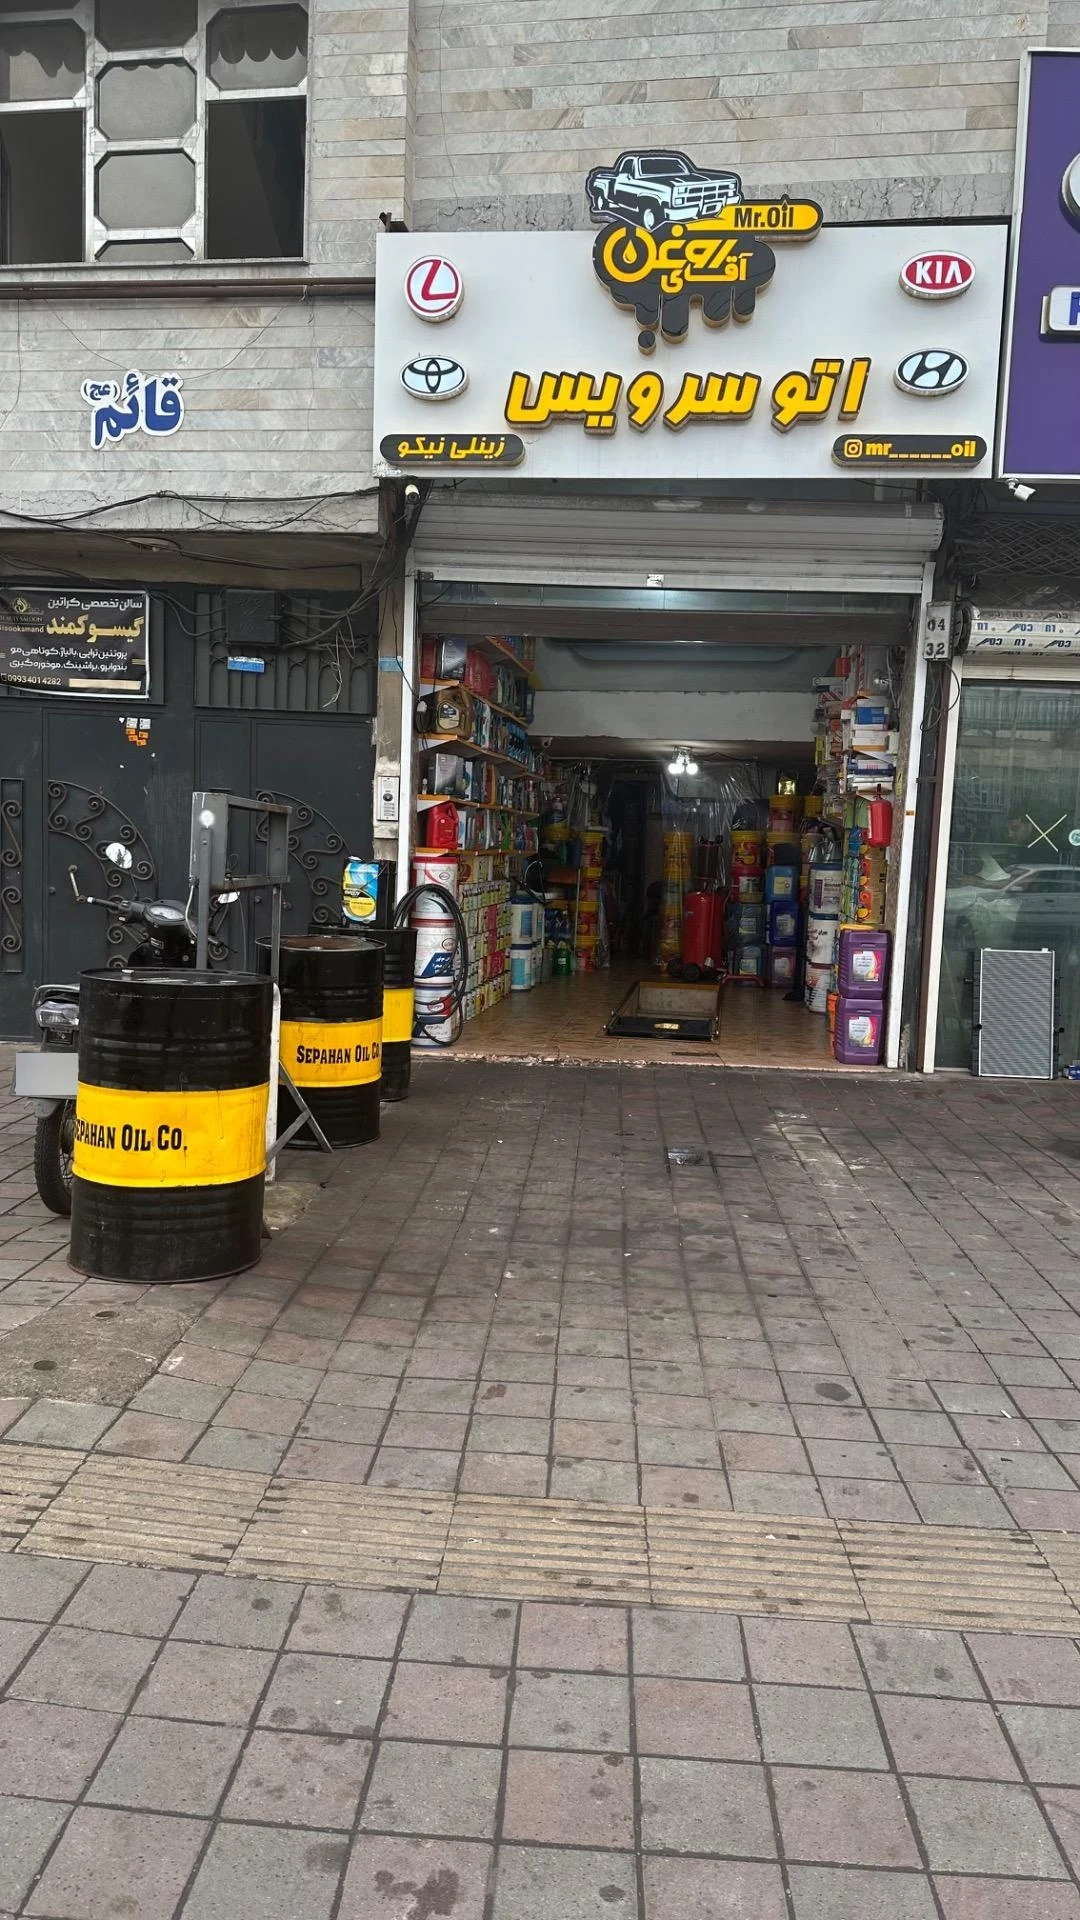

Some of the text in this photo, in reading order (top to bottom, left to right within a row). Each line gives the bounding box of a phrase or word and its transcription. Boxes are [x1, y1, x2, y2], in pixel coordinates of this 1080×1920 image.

[734, 203, 794, 228] Mr.Oil
[603, 224, 738, 283] روغن
[660, 252, 753, 294] آقای
[914, 260, 963, 284] KIA
[504, 357, 871, 429] اتو سرویس
[397, 436, 505, 459] زینلی نیکو
[47, 596, 143, 611] سالن تخصصی کراتین
[46, 613, 145, 643] گیسو کمند
[927, 618, 946, 632] 04
[10, 646, 22, 655] مو
[926, 642, 946, 656] 32
[296, 1044, 352, 1064] SEPAHAN
[121, 1124, 152, 1151] OIL
[157, 1124, 187, 1151] CO.
